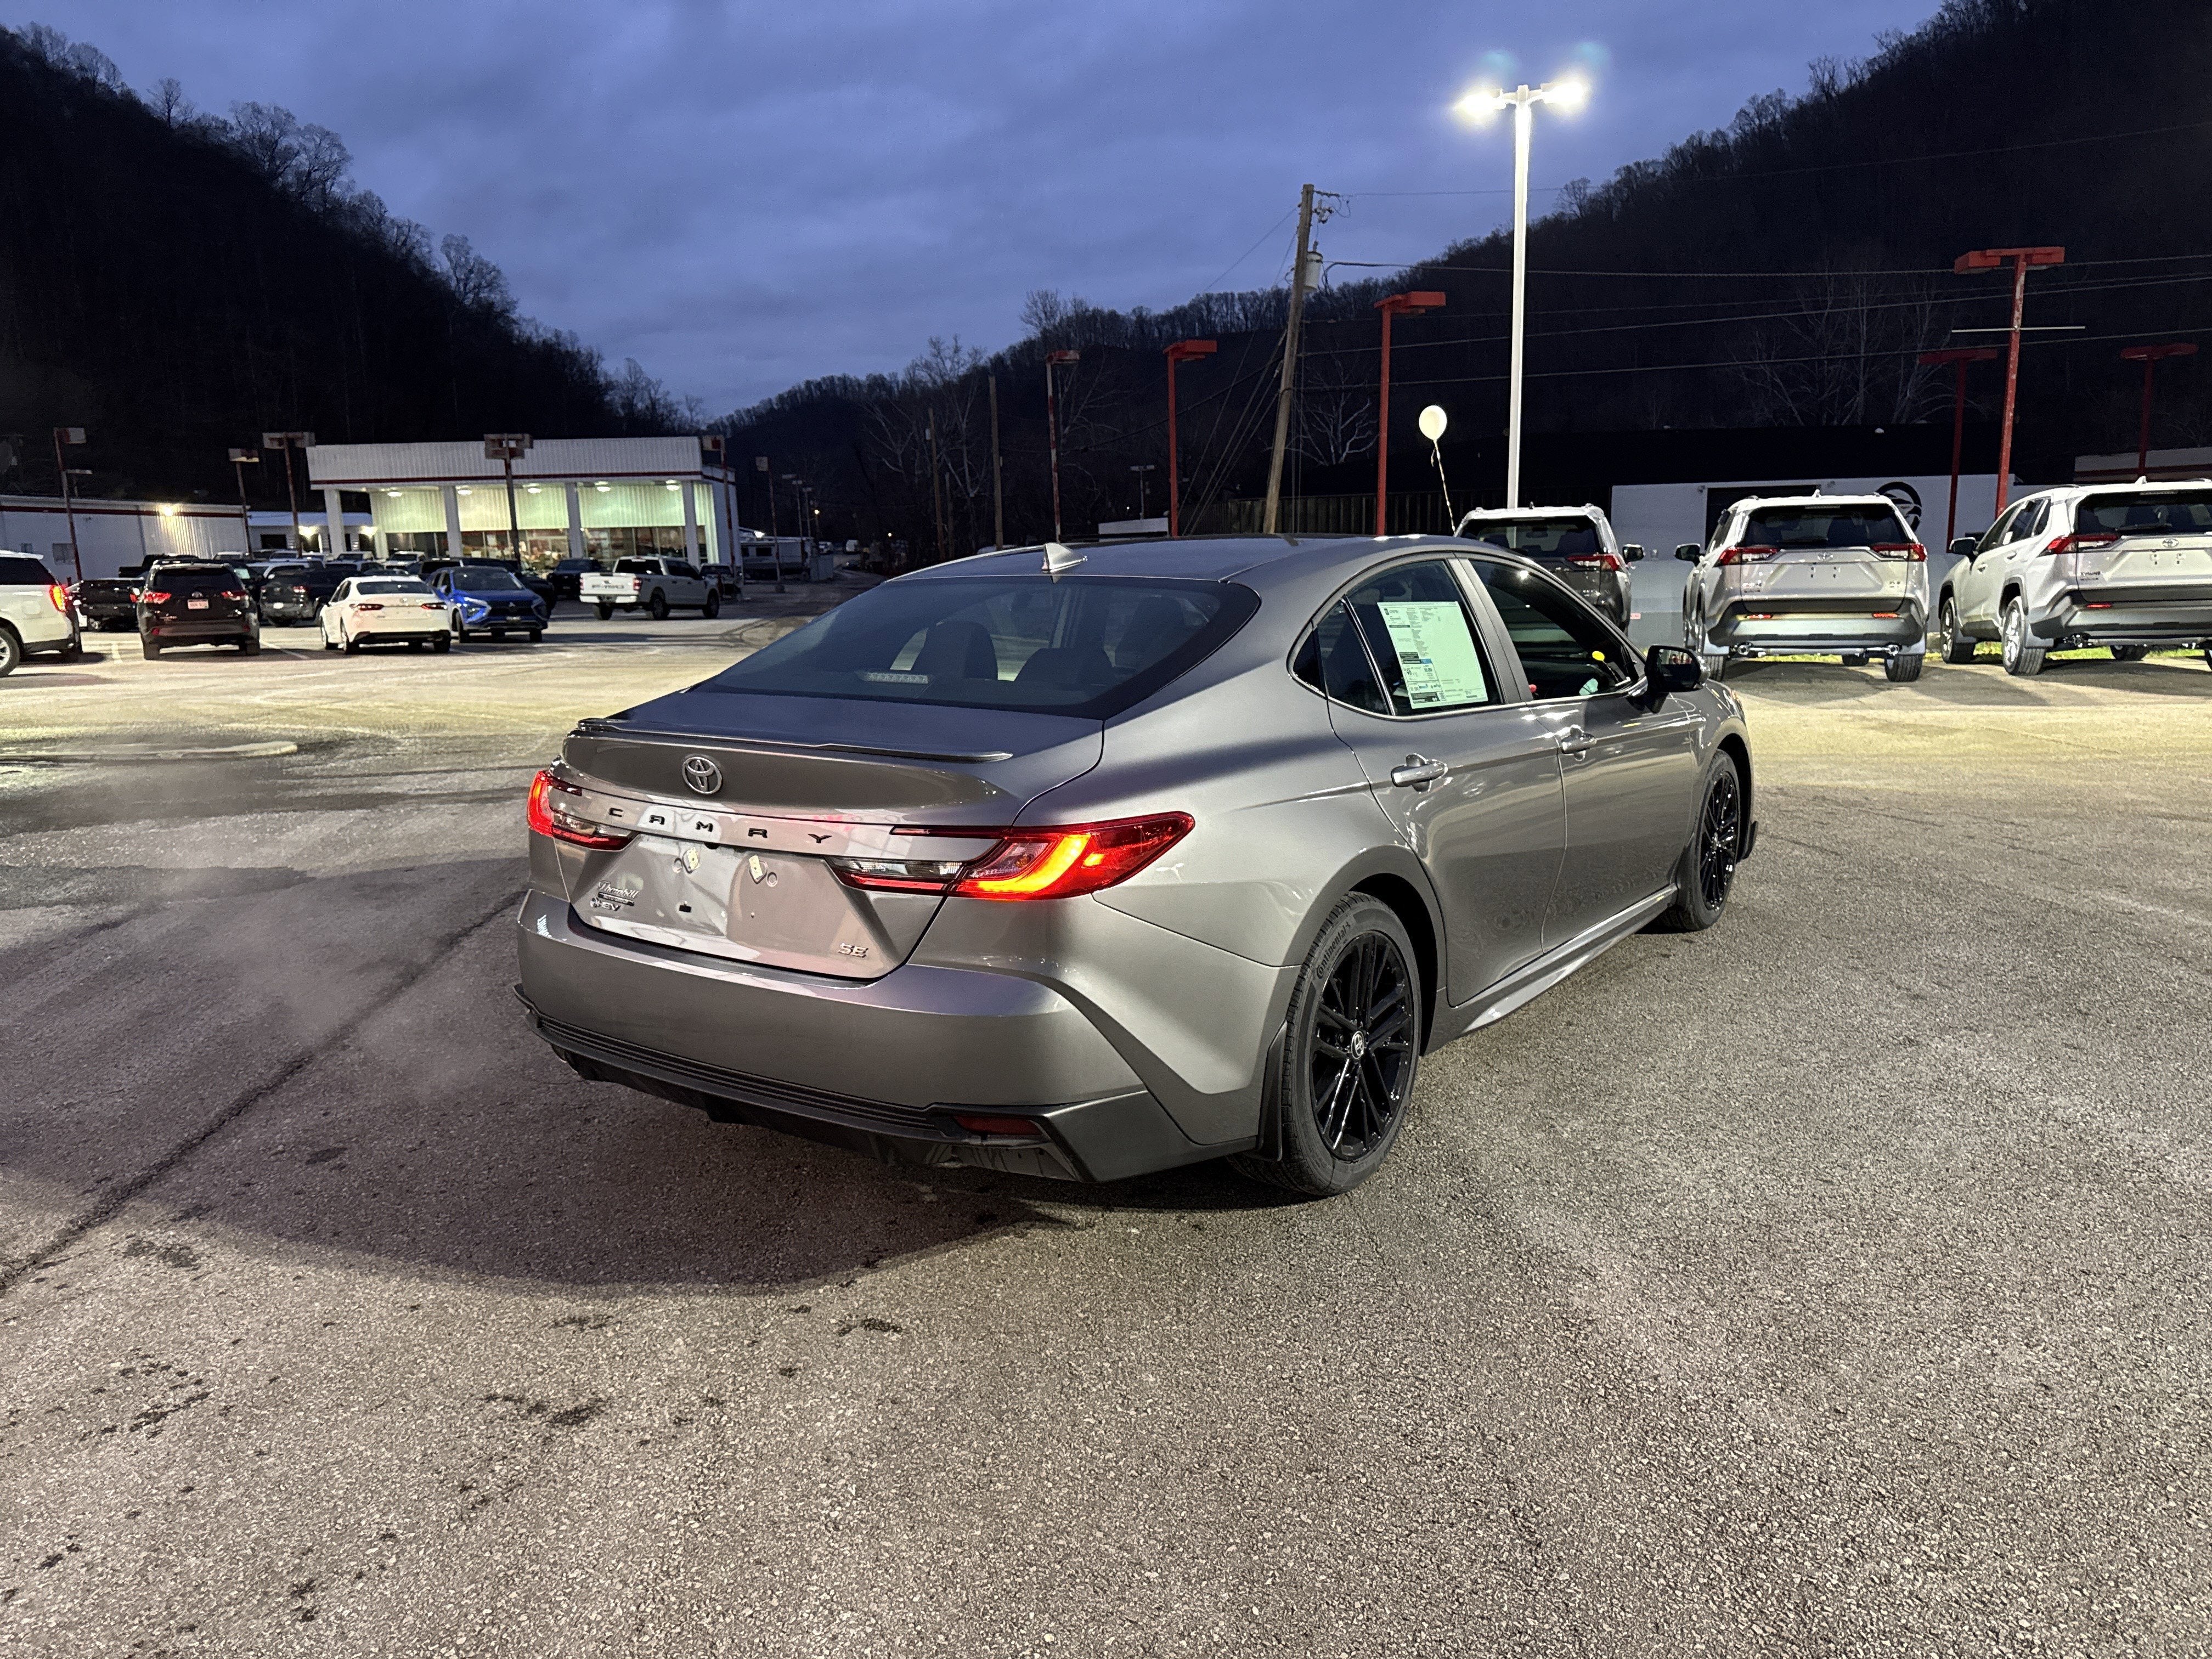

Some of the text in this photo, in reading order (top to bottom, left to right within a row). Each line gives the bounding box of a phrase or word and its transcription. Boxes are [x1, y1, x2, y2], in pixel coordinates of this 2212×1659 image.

[608, 807, 832, 844] CAMRY
[838, 943, 868, 958] SE
[1317, 924, 1347, 979] Continental
